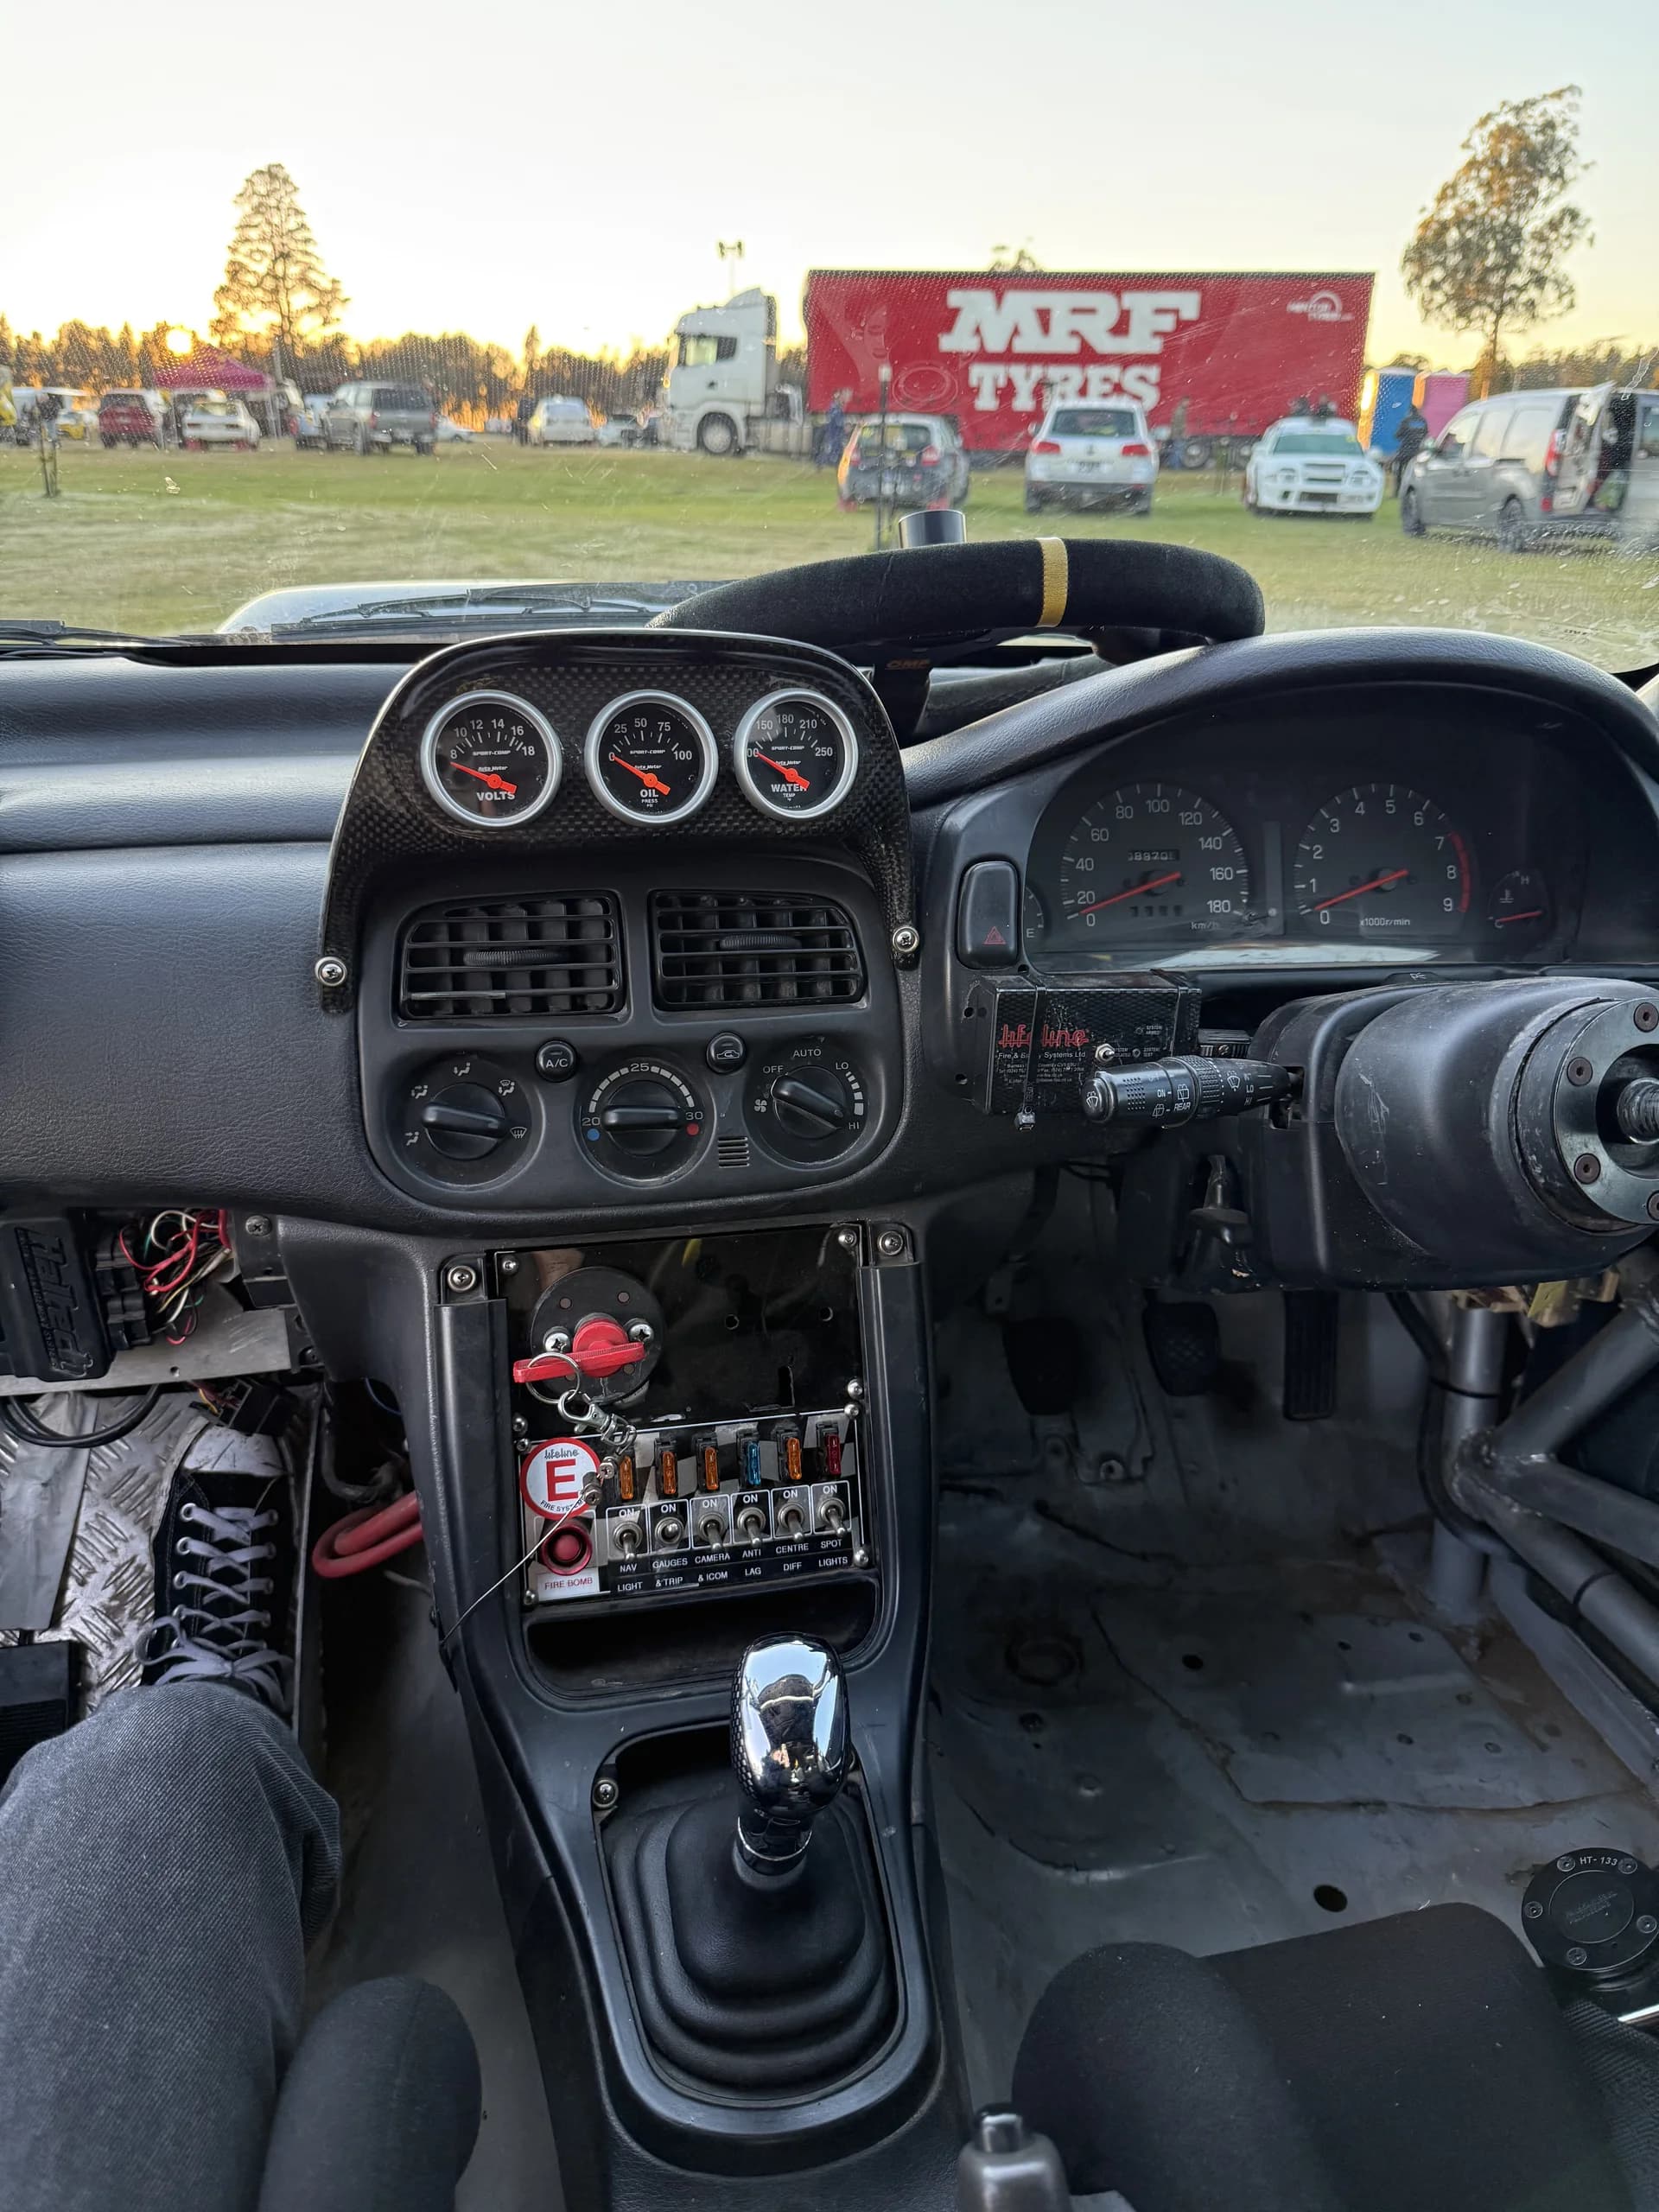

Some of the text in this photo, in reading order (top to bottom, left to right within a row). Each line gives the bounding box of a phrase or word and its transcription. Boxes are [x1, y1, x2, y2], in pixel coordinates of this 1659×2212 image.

[938, 290, 1201, 354] MRF
[969, 364, 1161, 412] TYRES
[470, 719, 484, 730] 12
[491, 718, 505, 729] 14
[634, 717, 648, 728] 50
[777, 714, 794, 724] 180
[799, 719, 817, 729] 210
[511, 725, 524, 736] 16
[614, 723, 627, 734] 25
[658, 721, 671, 732] 75
[755, 720, 773, 730] 150
[454, 727, 467, 738] 10
[450, 750, 458, 760] 8
[522, 746, 536, 756] 18
[673, 750, 693, 760] 100
[747, 747, 759, 758] 00
[815, 747, 833, 757] 250
[608, 752, 615, 762] 0
[771, 783, 808, 792] WATER
[476, 791, 516, 801] VOLTS
[639, 789, 659, 798] OIL
[1145, 799, 1170, 813] 100
[1355, 802, 1365, 816] 4
[1385, 799, 1396, 814] 5
[1116, 805, 1134, 819] 80
[1179, 811, 1203, 825] 120
[1414, 811, 1424, 826] 6
[1330, 818, 1340, 833] 3
[1090, 829, 1109, 842] 60
[1198, 836, 1223, 850] 140
[1434, 836, 1445, 850] 7
[1313, 844, 1324, 860] 2
[1076, 858, 1095, 871] 40
[1210, 867, 1234, 880] 160
[1446, 865, 1457, 880] 8
[1309, 878, 1317, 893] 1
[1520, 875, 1529, 885] H
[1077, 891, 1096, 905] 20
[1207, 899, 1231, 913] 180
[1443, 898, 1453, 912] 9
[1086, 913, 1096, 926] 0
[1319, 910, 1330, 925] 0
[1191, 921, 1220, 931] km/h
[1027, 928, 1035, 938] E
[792, 1048, 822, 1058] AUTO
[545, 1058, 569, 1068] A/C
[630, 1062, 650, 1072] 25
[836, 1061, 849, 1071] LO
[762, 1065, 784, 1074] OFF
[1157, 1089, 1166, 1098] ON
[1246, 1084, 1255, 1093] LO
[1173, 1102, 1192, 1111] REAR
[582, 1116, 601, 1127] 20
[685, 1111, 703, 1121] 30
[849, 1122, 860, 1130] HI
[544, 1447, 580, 1459] lifeline
[546, 1458, 579, 1503] E
[783, 1489, 798, 1499] ON
[823, 1484, 837, 1495] ON
[702, 1498, 717, 1509] ON
[742, 1493, 759, 1503] ON
[540, 1499, 555, 1511] FIRE
[660, 1503, 677, 1514] ON
[619, 1508, 635, 1518] ON
[775, 1542, 810, 1554] CENTRE
[820, 1539, 842, 1549] SPOT
[695, 1552, 731, 1564] CAMERA
[742, 1548, 761, 1559] ANTI
[652, 1558, 689, 1569] GAUGES
[783, 1561, 803, 1572] DIFF
[818, 1556, 849, 1567] LIGHTS
[620, 1563, 638, 1573] NAV
[745, 1567, 762, 1577] LAG
[655, 1576, 683, 1587] & TRIP
[697, 1571, 728, 1582] & ICOM
[544, 1577, 593, 1591] FIRE BOMB
[617, 1581, 644, 1592] LIGHT
